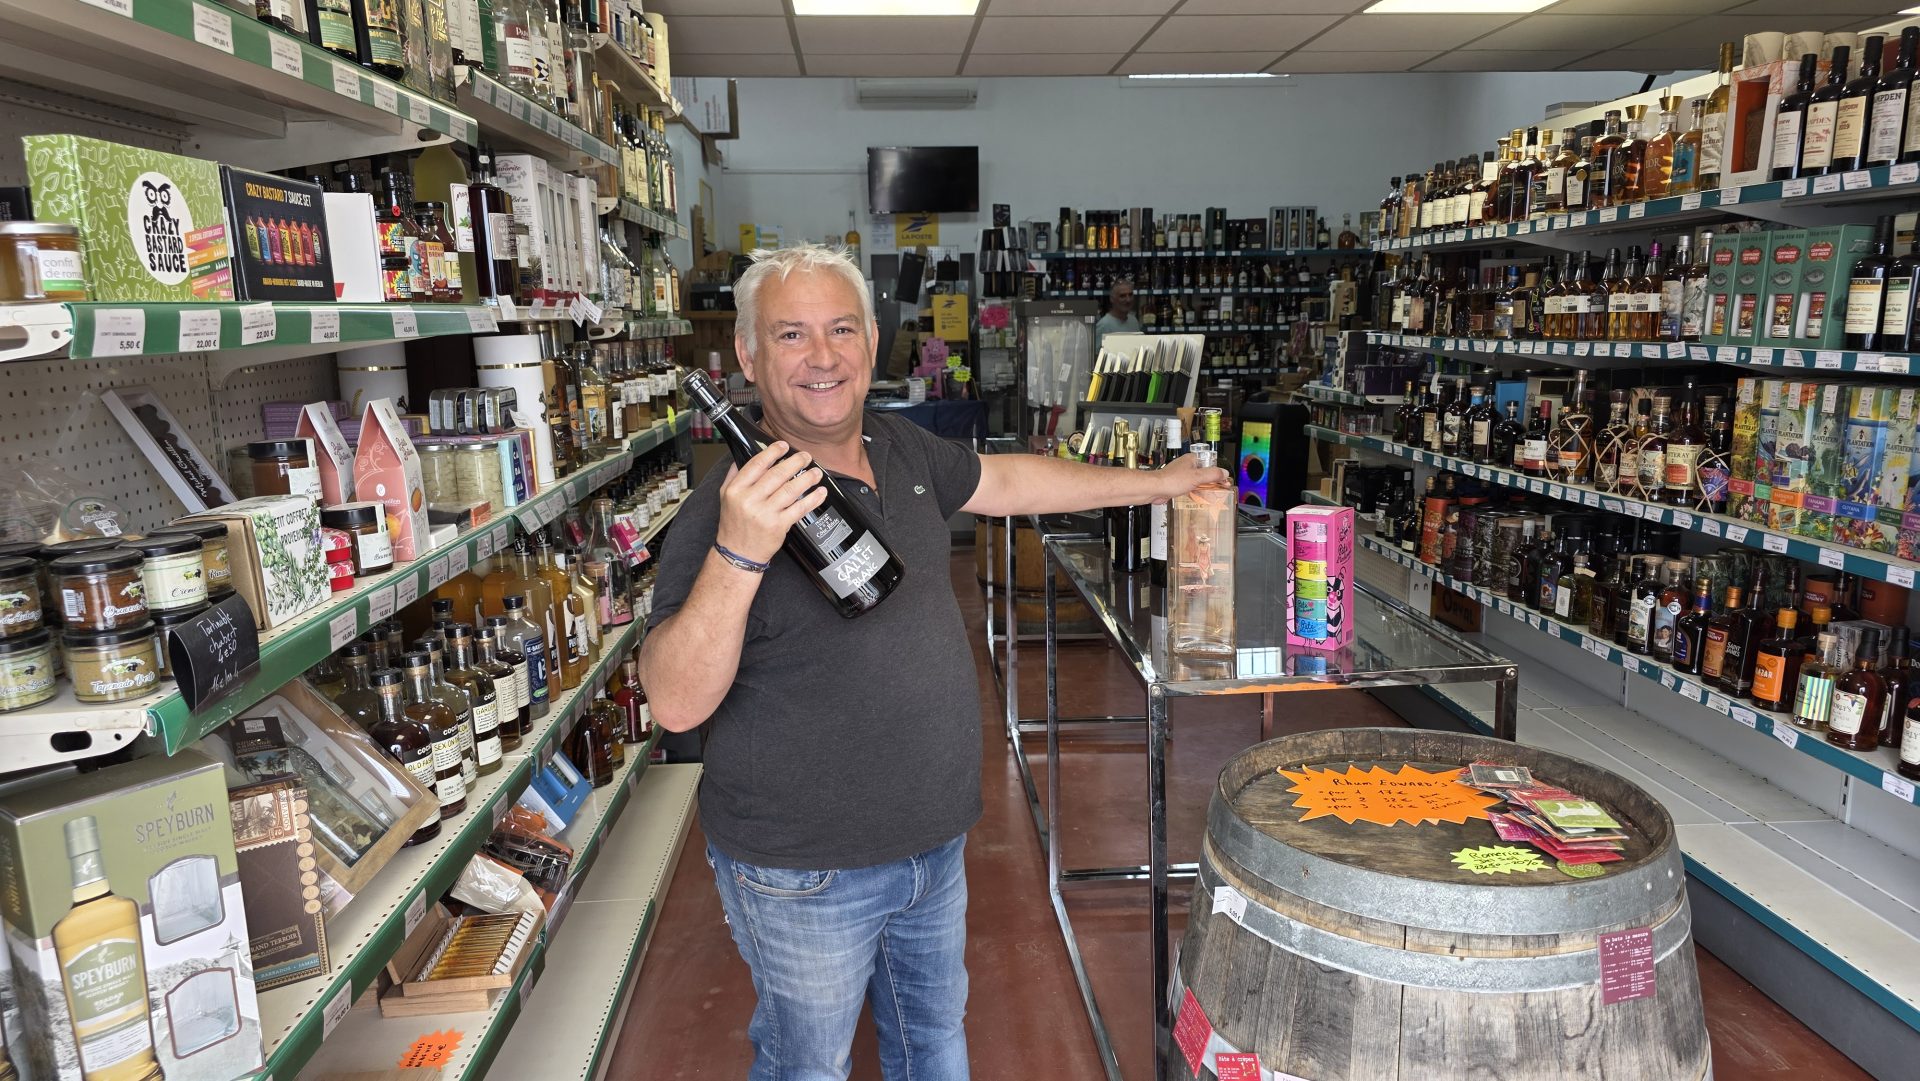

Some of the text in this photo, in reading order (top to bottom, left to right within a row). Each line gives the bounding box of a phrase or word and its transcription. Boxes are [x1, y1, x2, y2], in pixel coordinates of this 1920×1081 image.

[246, 182, 262, 198] CRAZY
[263, 187, 284, 202] BASTARD
[288, 191, 303, 205] SAUCE
[303, 194, 312, 207] SET
[143, 215, 180, 236] CRAZY
[145, 234, 183, 253] BASTARD
[43, 257, 73, 267] confit
[149, 253, 186, 273] SAUCE
[45, 269, 60, 278] de
[256, 330, 269, 339] 22,00
[119, 341, 141, 350] 5,50 €
[196, 340, 217, 349] 22,00 €
[1778, 430, 1803, 439] PLANTATION
[1812, 435, 1838, 443] PLANTATION
[1846, 439, 1874, 448] PLANTATION
[1808, 498, 1825, 506] PANAMA
[1841, 504, 1860, 512] GUYANA
[285, 508, 308, 525] COFFRET
[852, 562, 878, 588] BLANC
[91, 679, 134, 694] Tapenade
[434, 743, 447, 752] SEX
[408, 763, 422, 772] OLD
[1333, 778, 1373, 786] Rhum
[136, 803, 214, 844] SPEYBURN
[269, 933, 297, 947] TERROIR
[72, 954, 136, 989] SPEYBURN
